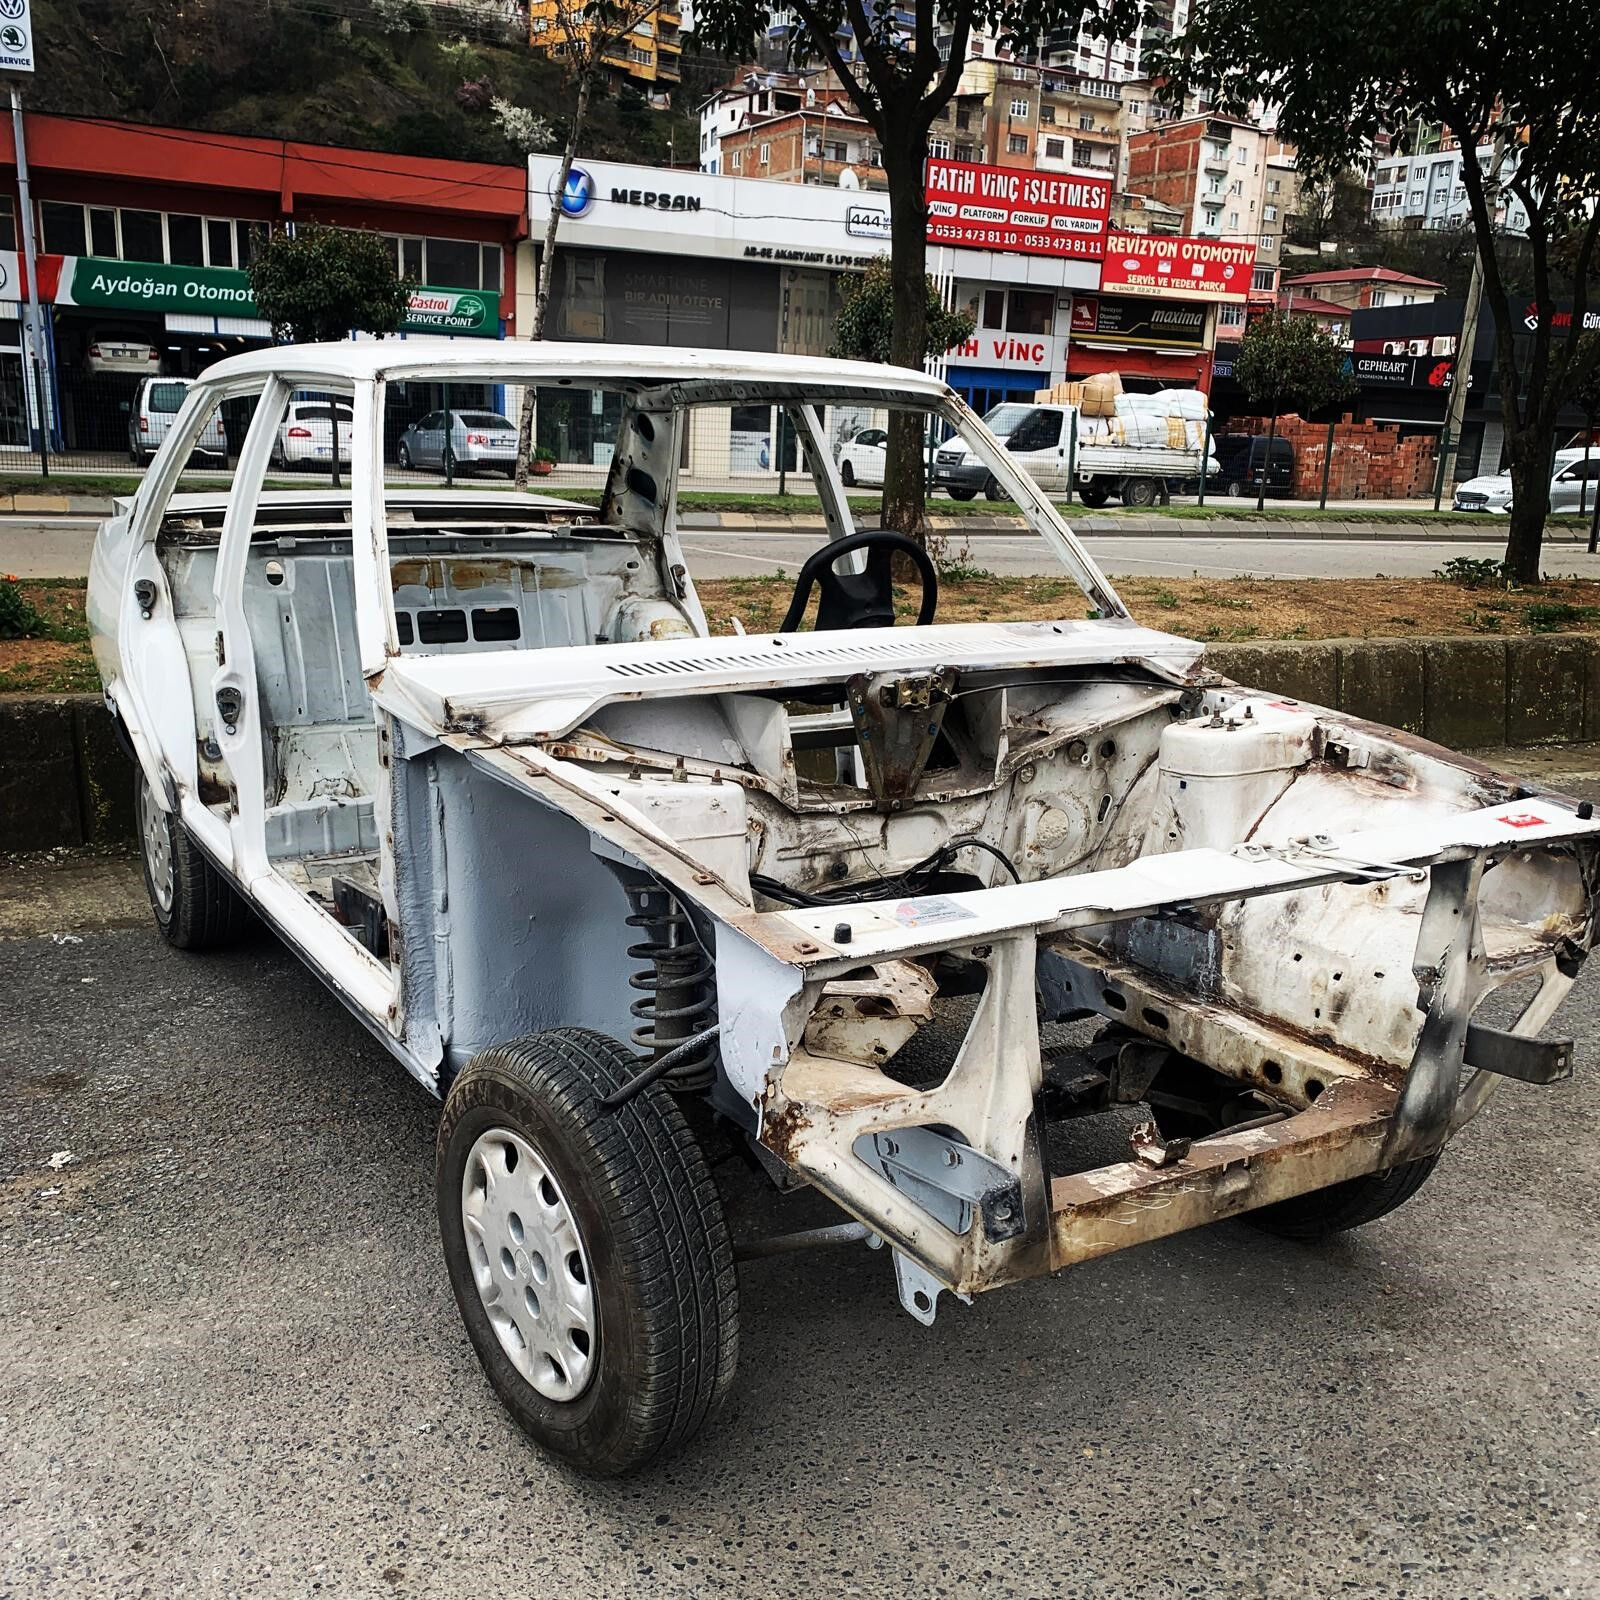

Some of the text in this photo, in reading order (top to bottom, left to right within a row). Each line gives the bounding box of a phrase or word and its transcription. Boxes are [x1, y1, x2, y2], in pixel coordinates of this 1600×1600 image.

[611, 188, 701, 212] MEPSAN
[934, 203, 953, 215] VİNÇ
[963, 208, 1005, 220] PLATFORM
[851, 214, 880, 227] 444
[1054, 219, 1099, 231] YOL YARDIM
[935, 224, 963, 239] 0533
[965, 229, 985, 242] 473
[988, 231, 1001, 243] 81
[1004, 232, 1017, 245] 10
[1025, 235, 1051, 248] 0533
[1053, 238, 1072, 251] 473
[1074, 240, 1087, 252] 81
[1089, 242, 1101, 254] 11
[1107, 235, 1255, 265] REVİZYON OTOMOTİV
[835, 255, 852, 266] LPG
[91, 274, 255, 302] Aydoğan Otomot
[1127, 274, 1156, 286] SERVİS
[1158, 277, 1168, 287] VE
[1171, 278, 1197, 289] YEDEK
[1199, 281, 1226, 292] PARÇA
[410, 297, 449, 311] Castrol
[406, 313, 473, 327] SERVICE POINT
[1151, 308, 1203, 326] maxima
[993, 339, 1045, 366] VİNÇ
[1358, 360, 1407, 373] CEPHEART
